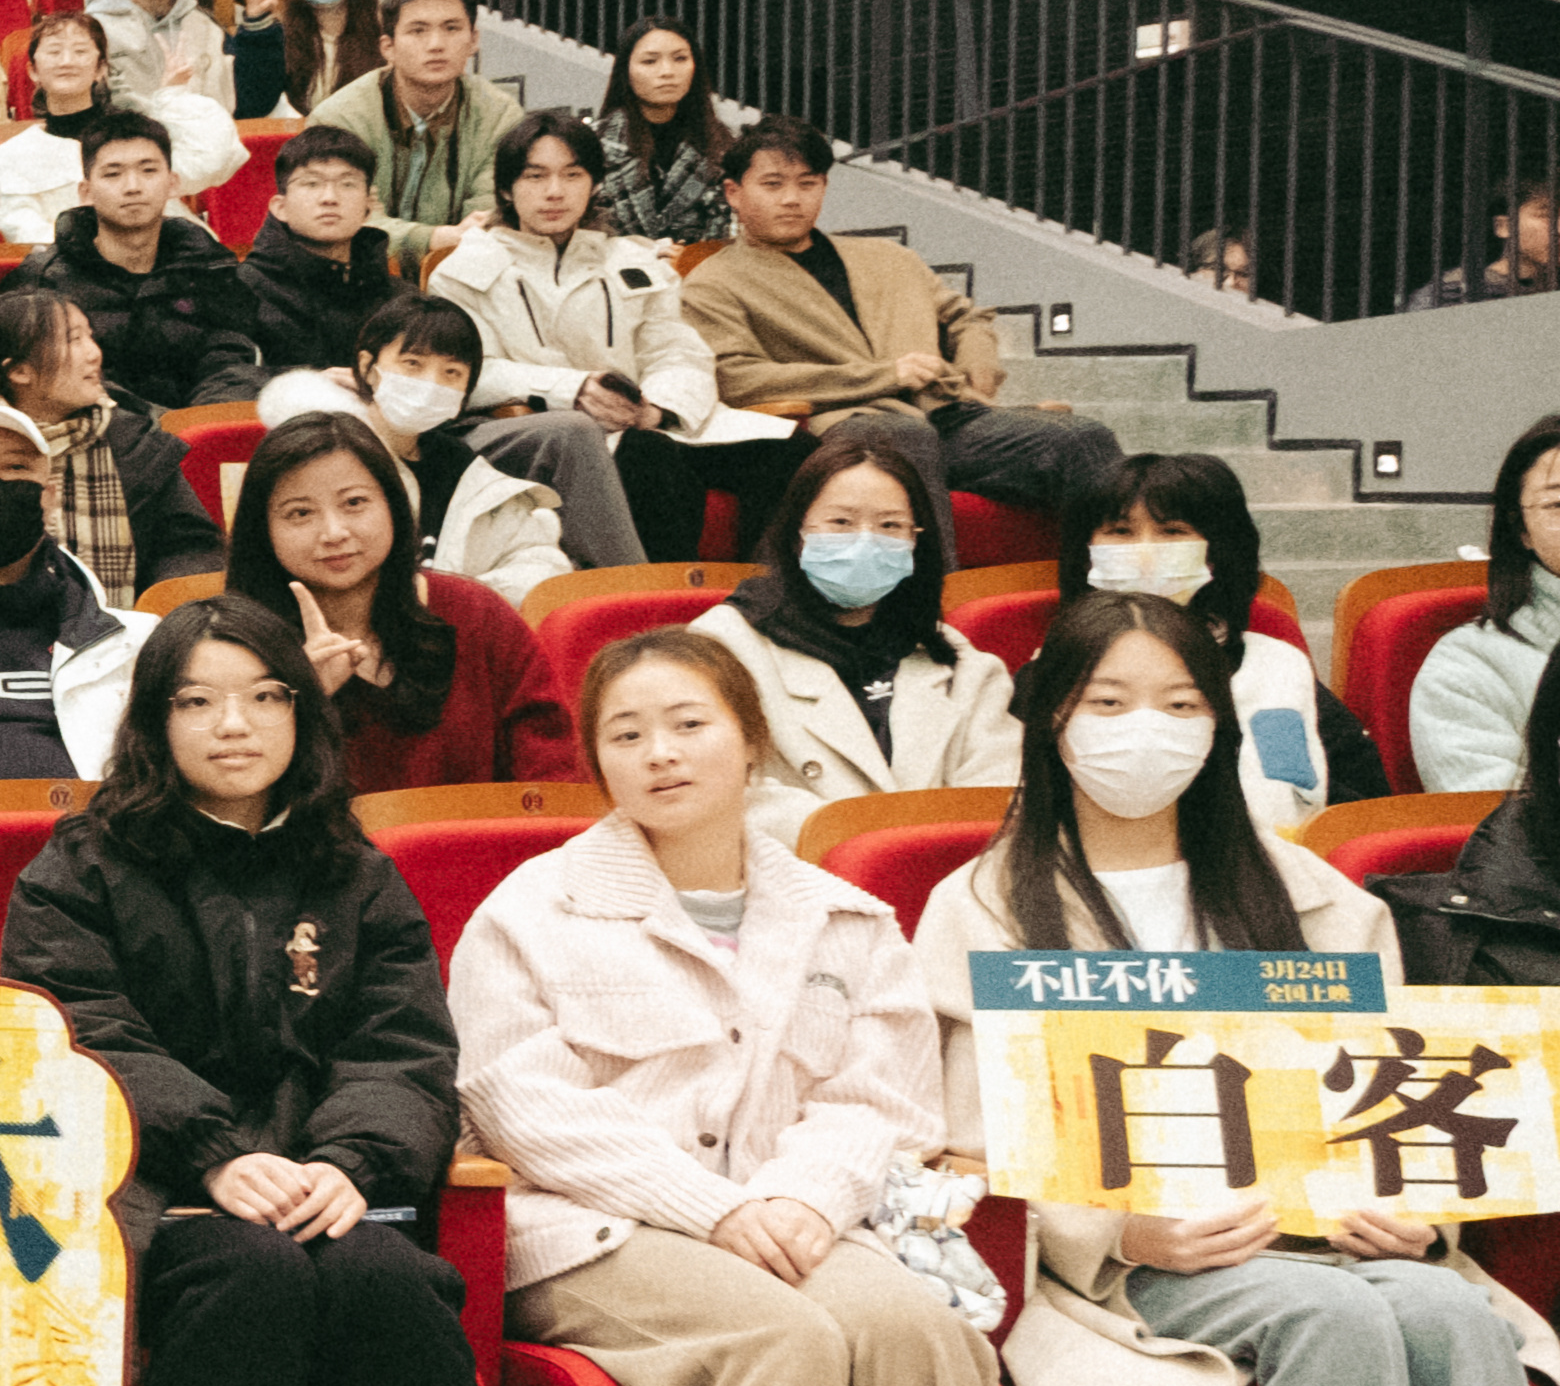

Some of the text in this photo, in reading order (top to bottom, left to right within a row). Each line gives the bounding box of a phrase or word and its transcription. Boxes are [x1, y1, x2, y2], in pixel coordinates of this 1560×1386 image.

[1012, 957, 1198, 1004] 不止不休
[1258, 959, 1348, 982] 3月24日
[1263, 982, 1352, 1004] 全国上映
[1089, 1026, 1520, 1200] 白客
